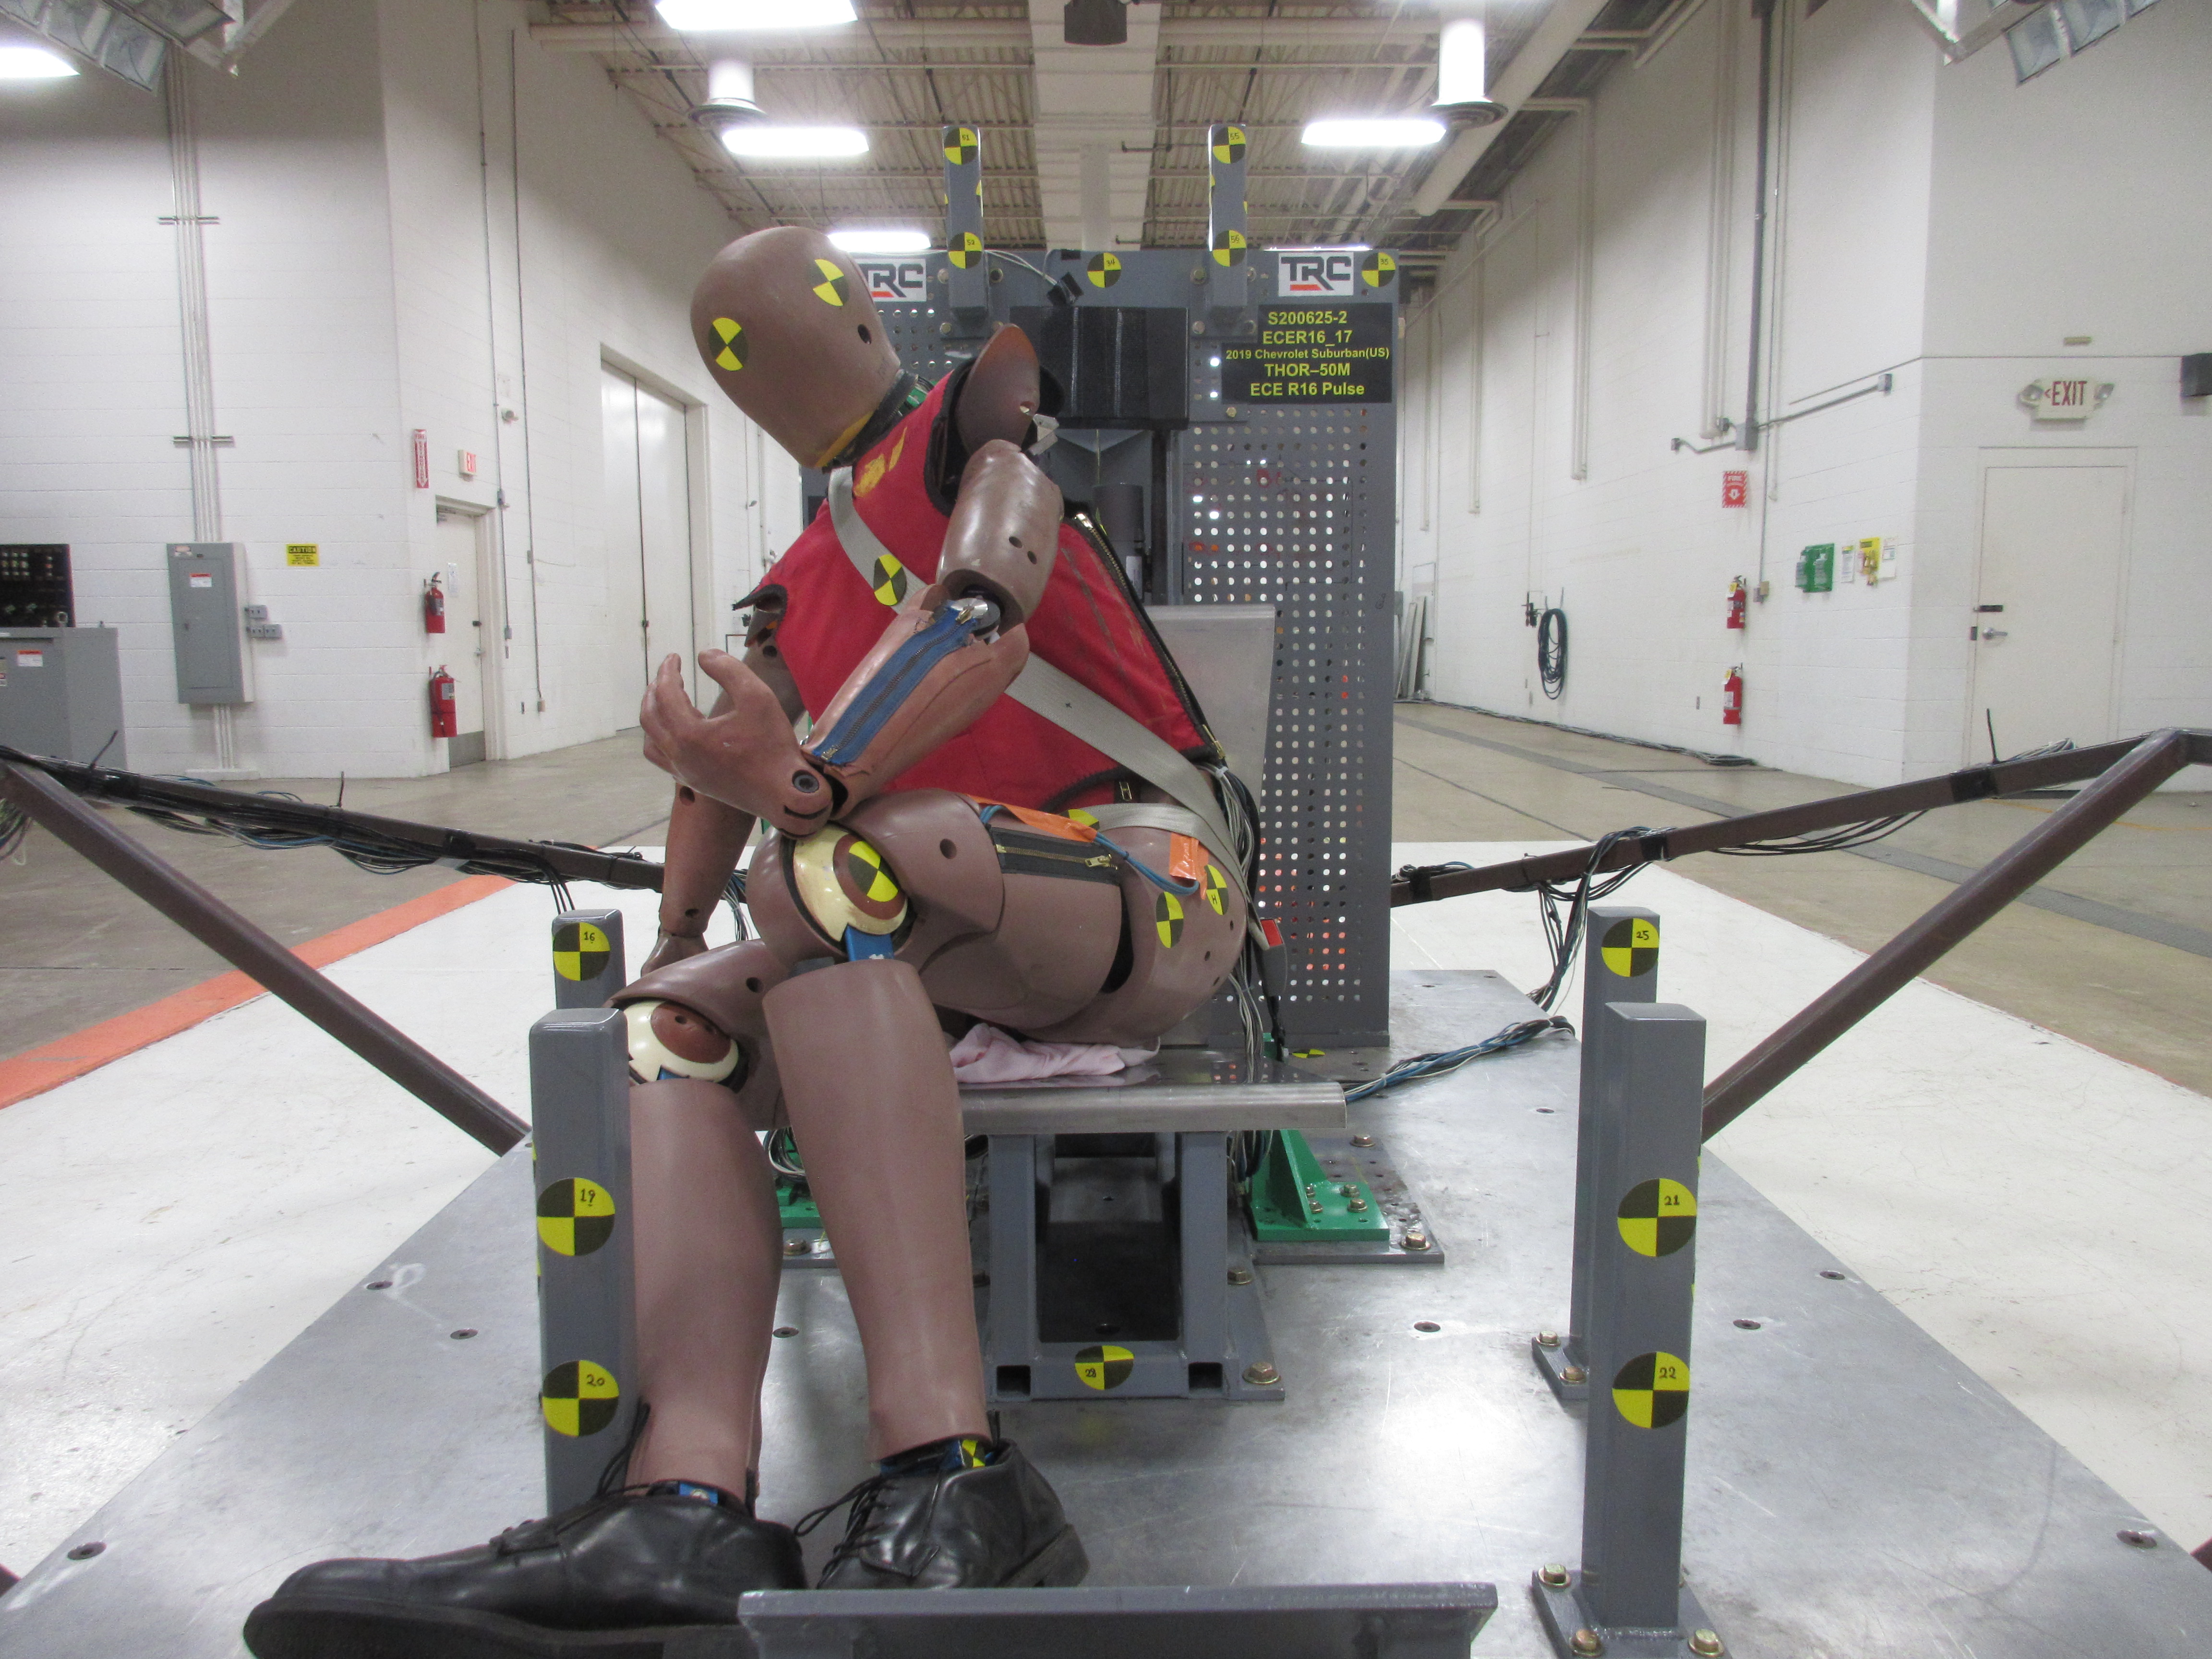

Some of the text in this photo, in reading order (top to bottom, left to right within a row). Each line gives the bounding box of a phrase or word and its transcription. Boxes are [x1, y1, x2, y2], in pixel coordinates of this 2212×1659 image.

[1281, 256, 1351, 290] TRC
[1268, 311, 1347, 325] S200625-2
[1262, 330, 1353, 346] ECER16_17
[1226, 348, 1390, 360] 2019 Chevrolet Suburban(US)
[1250, 382, 1365, 396] ECE R16 Pulse
[2052, 381, 2088, 406] EXIT
[1211, 894, 1217, 905] H
[584, 932, 595, 941] 16
[1636, 930, 1649, 940] 25
[580, 1189, 596, 1203] 19
[1664, 1195, 1680, 1205] 21
[1659, 1366, 1676, 1379] 22
[586, 1374, 605, 1387] 20
